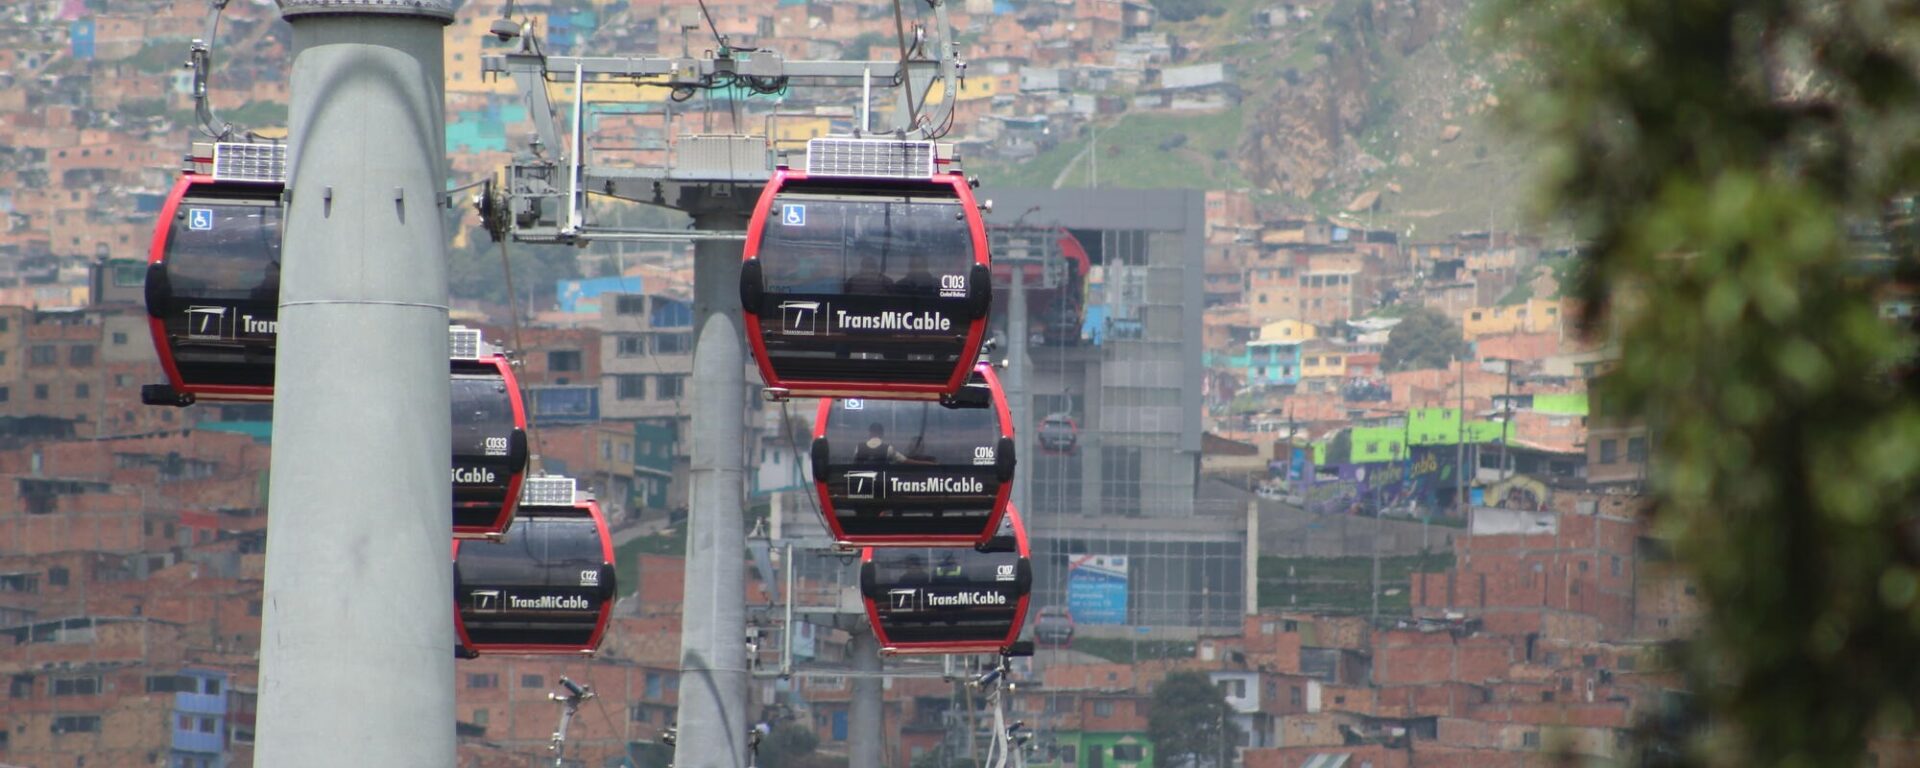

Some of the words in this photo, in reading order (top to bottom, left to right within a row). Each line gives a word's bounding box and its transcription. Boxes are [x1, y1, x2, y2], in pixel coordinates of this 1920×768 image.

[941, 275, 965, 289] C103
[837, 310, 950, 330] TransMiCable
[485, 437, 507, 449] C033
[975, 446, 994, 458] C016
[891, 477, 983, 493] TransMiCable
[580, 570, 598, 580] C122
[997, 565, 1013, 575] C107
[510, 595, 589, 609] TransMiCable
[928, 591, 1006, 606] TransMiCable
